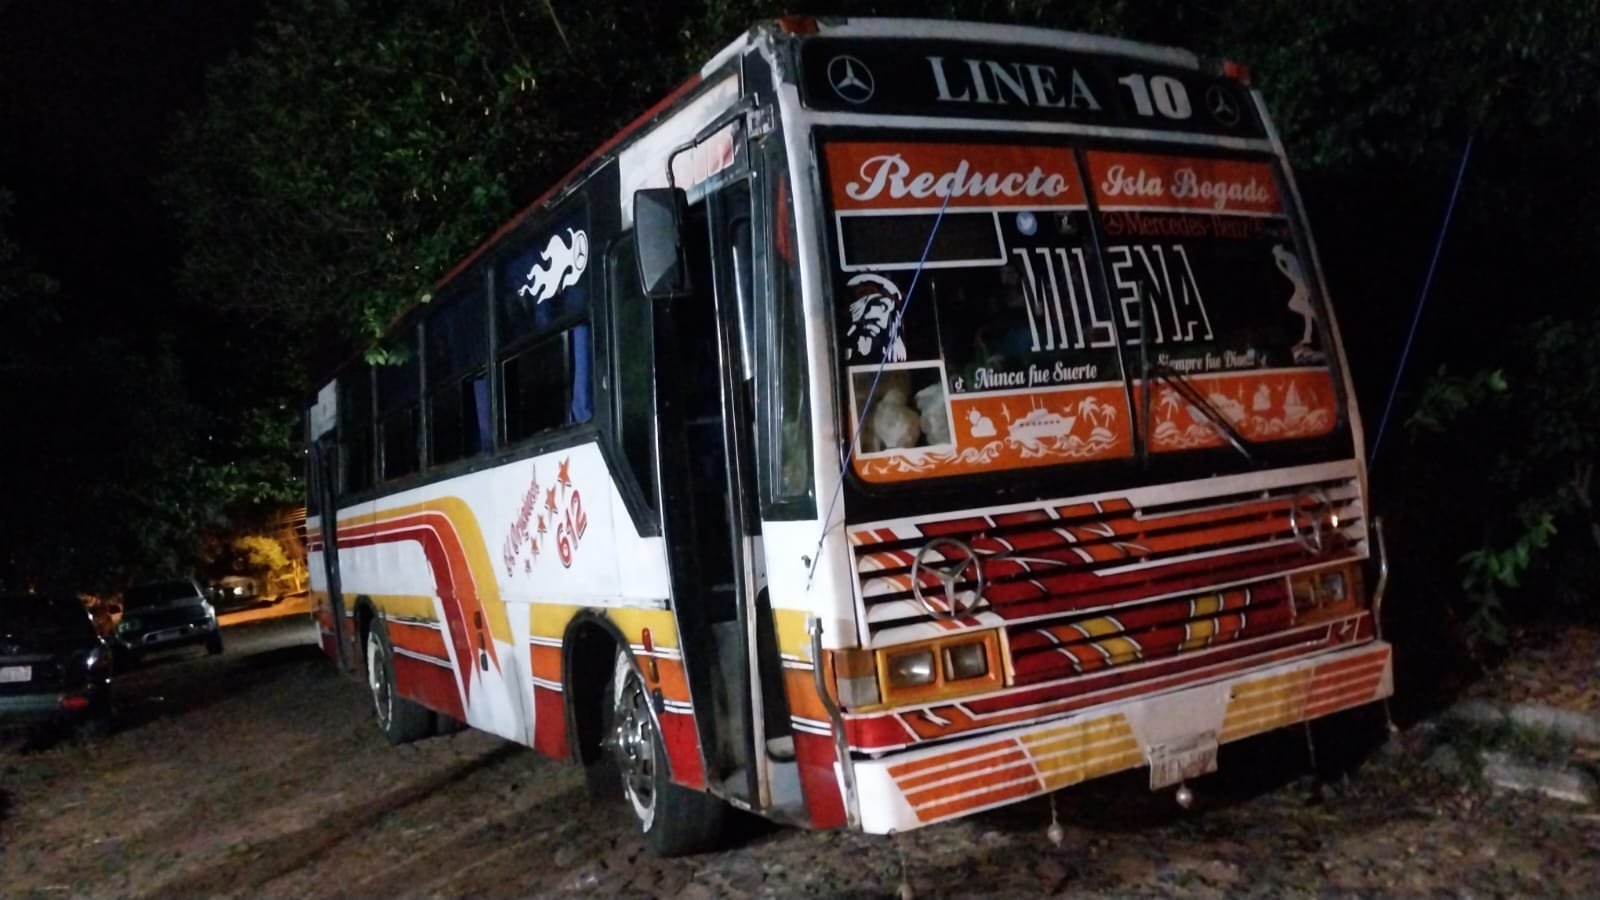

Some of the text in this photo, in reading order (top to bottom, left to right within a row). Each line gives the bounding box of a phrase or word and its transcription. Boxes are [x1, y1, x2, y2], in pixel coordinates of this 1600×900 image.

[926, 56, 1192, 120] LINEA 10
[846, 154, 1070, 201] Reducto
[1102, 165, 1270, 210] Isla Bogado
[974, 360, 1098, 389] Nunca fue Suerte
[557, 489, 588, 569] 612
